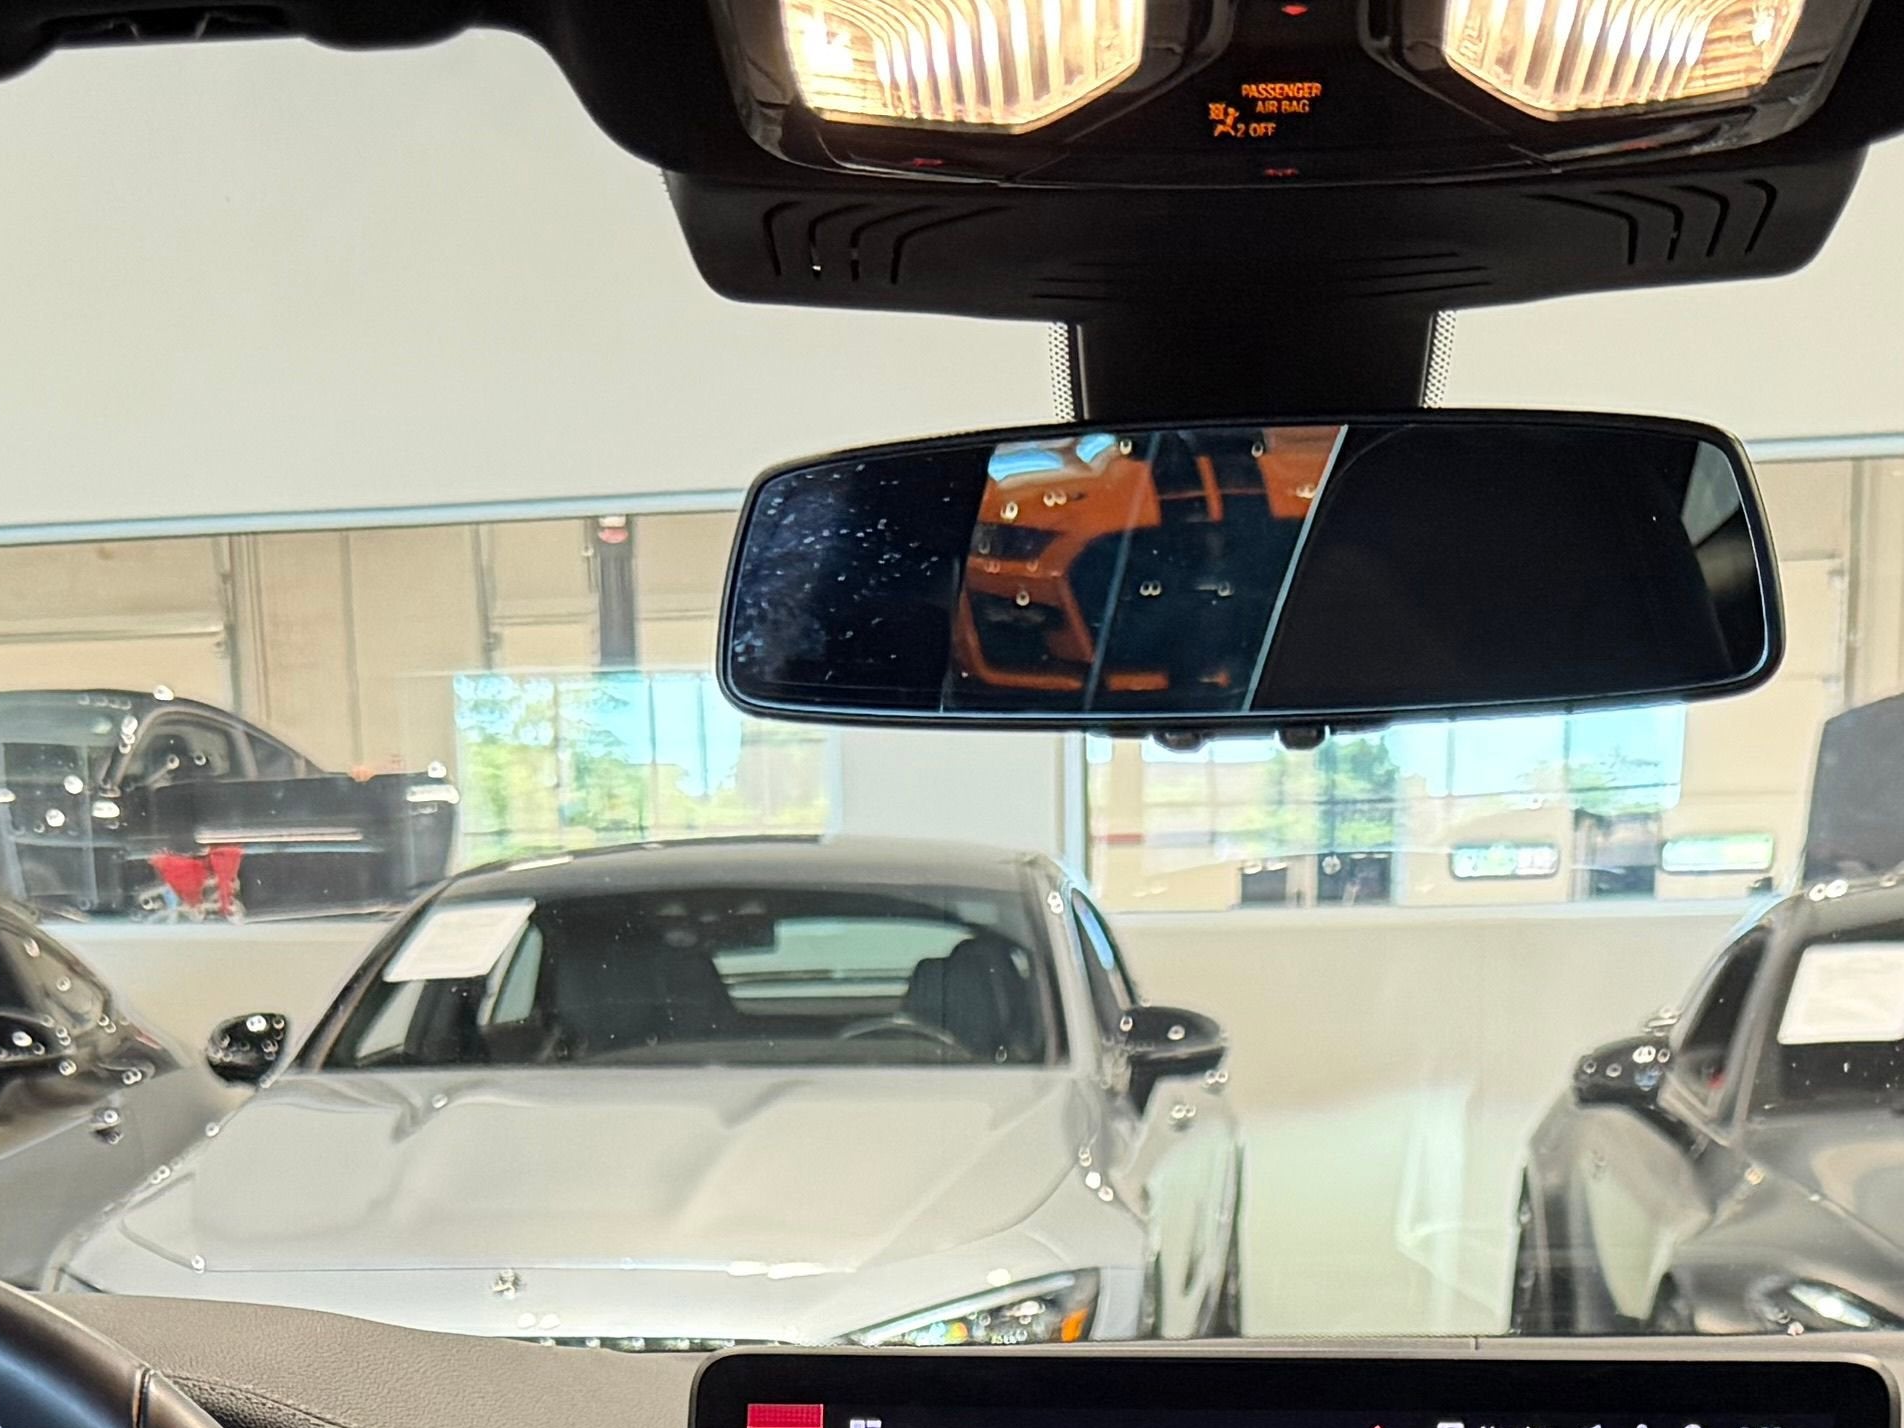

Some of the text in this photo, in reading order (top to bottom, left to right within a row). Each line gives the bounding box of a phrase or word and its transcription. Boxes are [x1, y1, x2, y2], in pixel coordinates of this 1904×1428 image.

[1242, 83, 1322, 98] PASSENGER
[1256, 100, 1309, 113] AIR BAG
[1249, 124, 1276, 137] OFF
